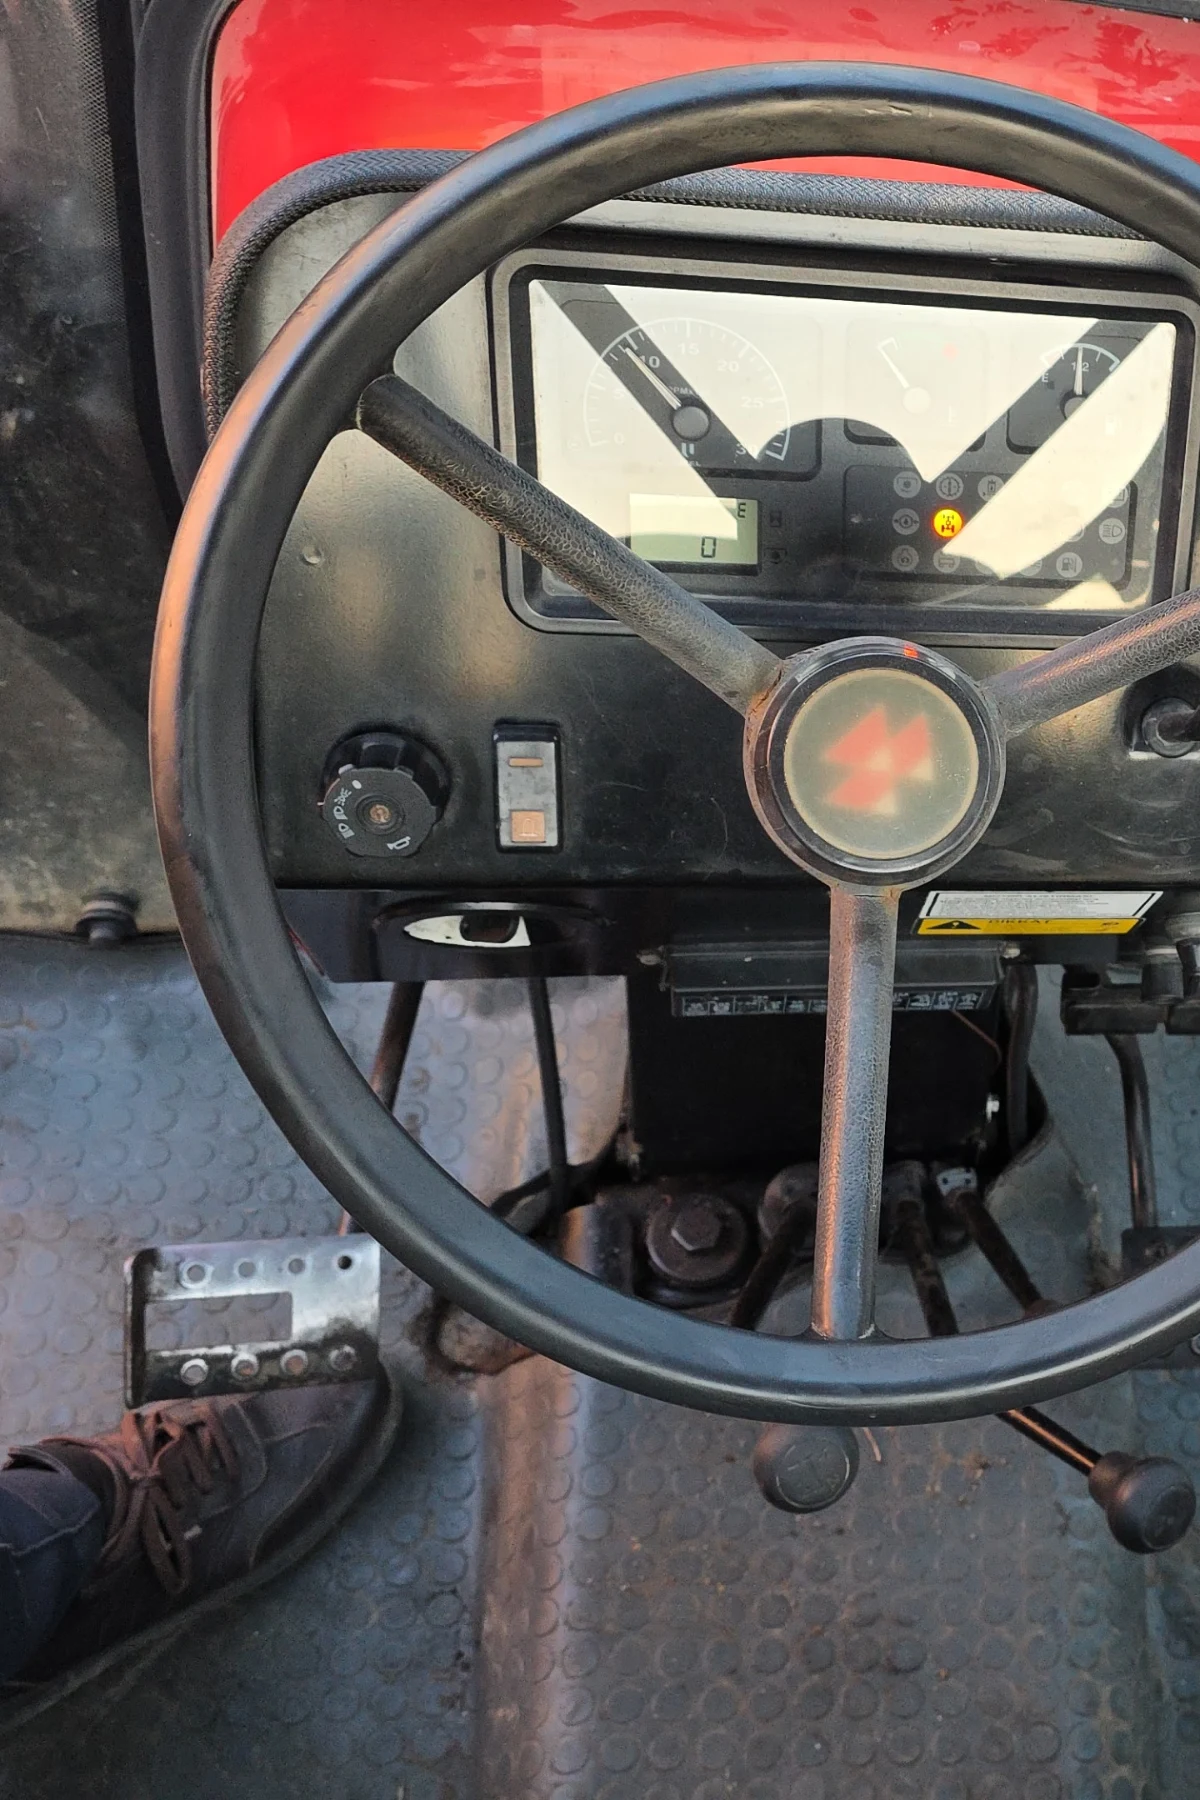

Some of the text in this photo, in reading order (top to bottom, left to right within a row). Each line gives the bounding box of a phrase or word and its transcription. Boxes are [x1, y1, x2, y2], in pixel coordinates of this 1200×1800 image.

[679, 343, 699, 355] 15
[718, 361, 740, 372] 20
[613, 388, 625, 400] 5
[742, 397, 764, 408] 25
[614, 432, 625, 444] 0
[738, 503, 746, 518] E
[701, 537, 717, 558] 0
